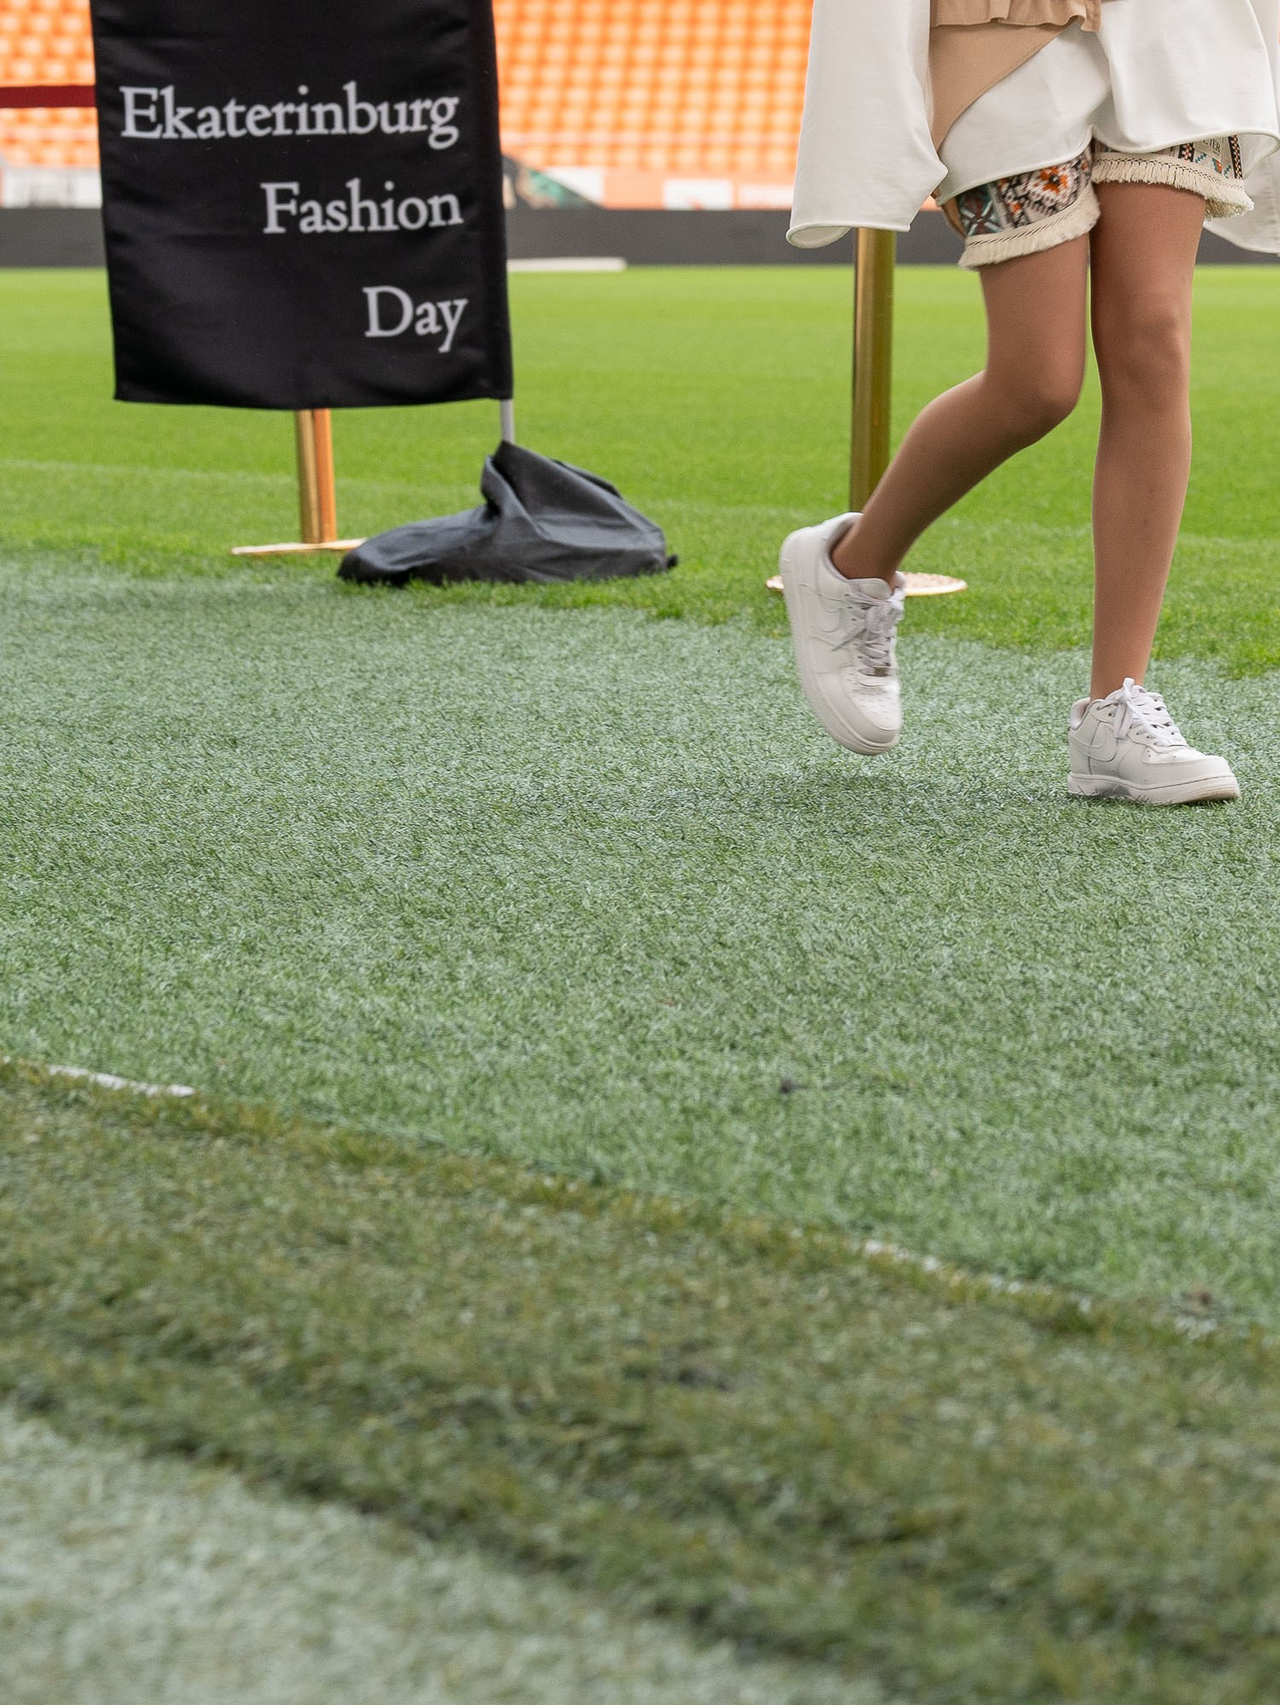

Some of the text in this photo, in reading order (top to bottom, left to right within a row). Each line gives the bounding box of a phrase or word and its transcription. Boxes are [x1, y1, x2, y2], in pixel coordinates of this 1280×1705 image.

[119, 80, 460, 150] Ekaterinburg
[260, 177, 464, 234] Fashion
[362, 285, 468, 353] Day
